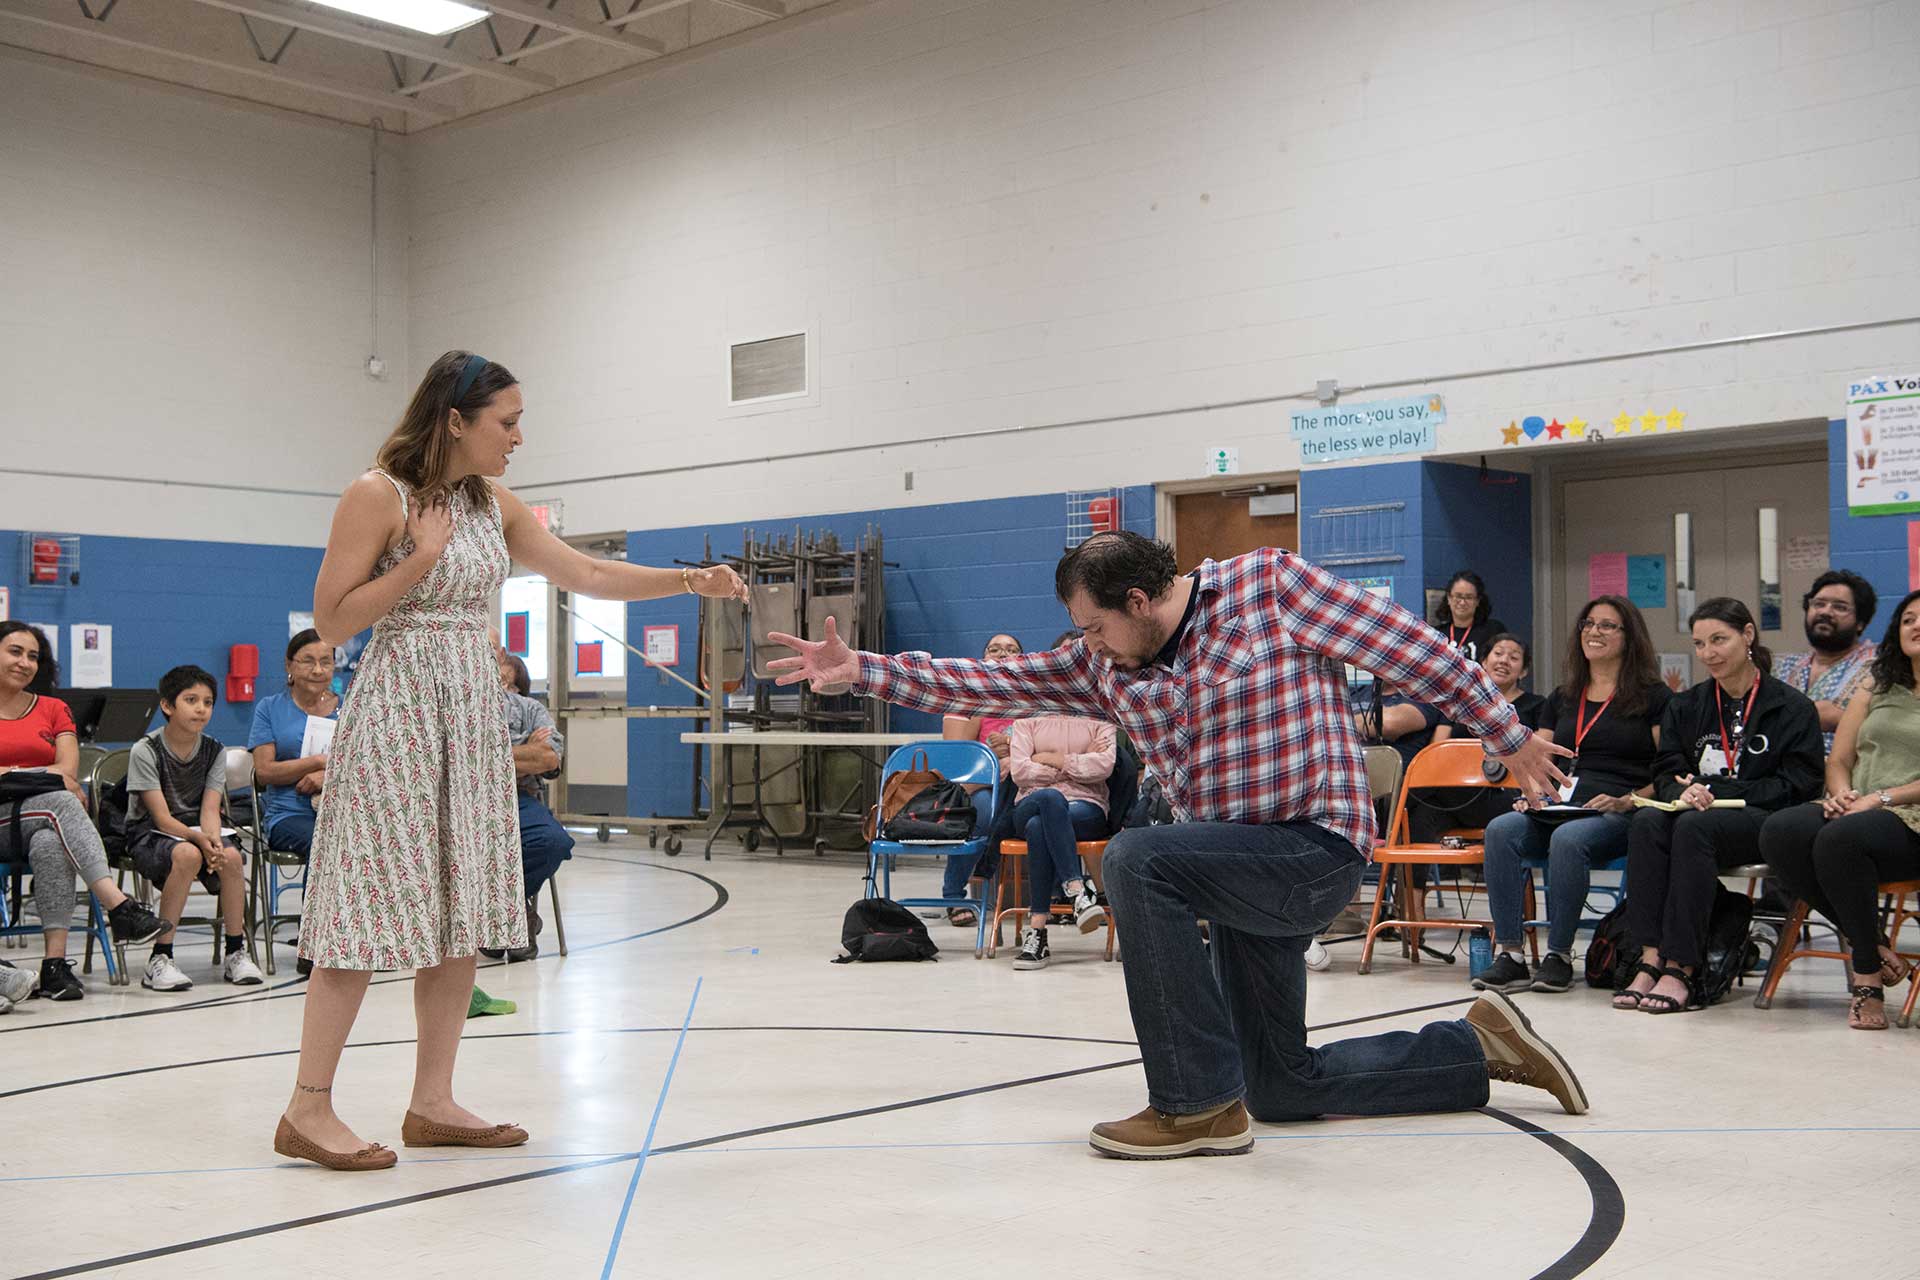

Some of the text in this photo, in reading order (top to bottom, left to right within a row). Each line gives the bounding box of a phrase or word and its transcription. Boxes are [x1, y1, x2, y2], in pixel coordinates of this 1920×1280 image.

[1850, 381, 1888, 396] PAX
[1292, 404, 1429, 430] The more you say,
[1303, 427, 1427, 455] the less we play!
